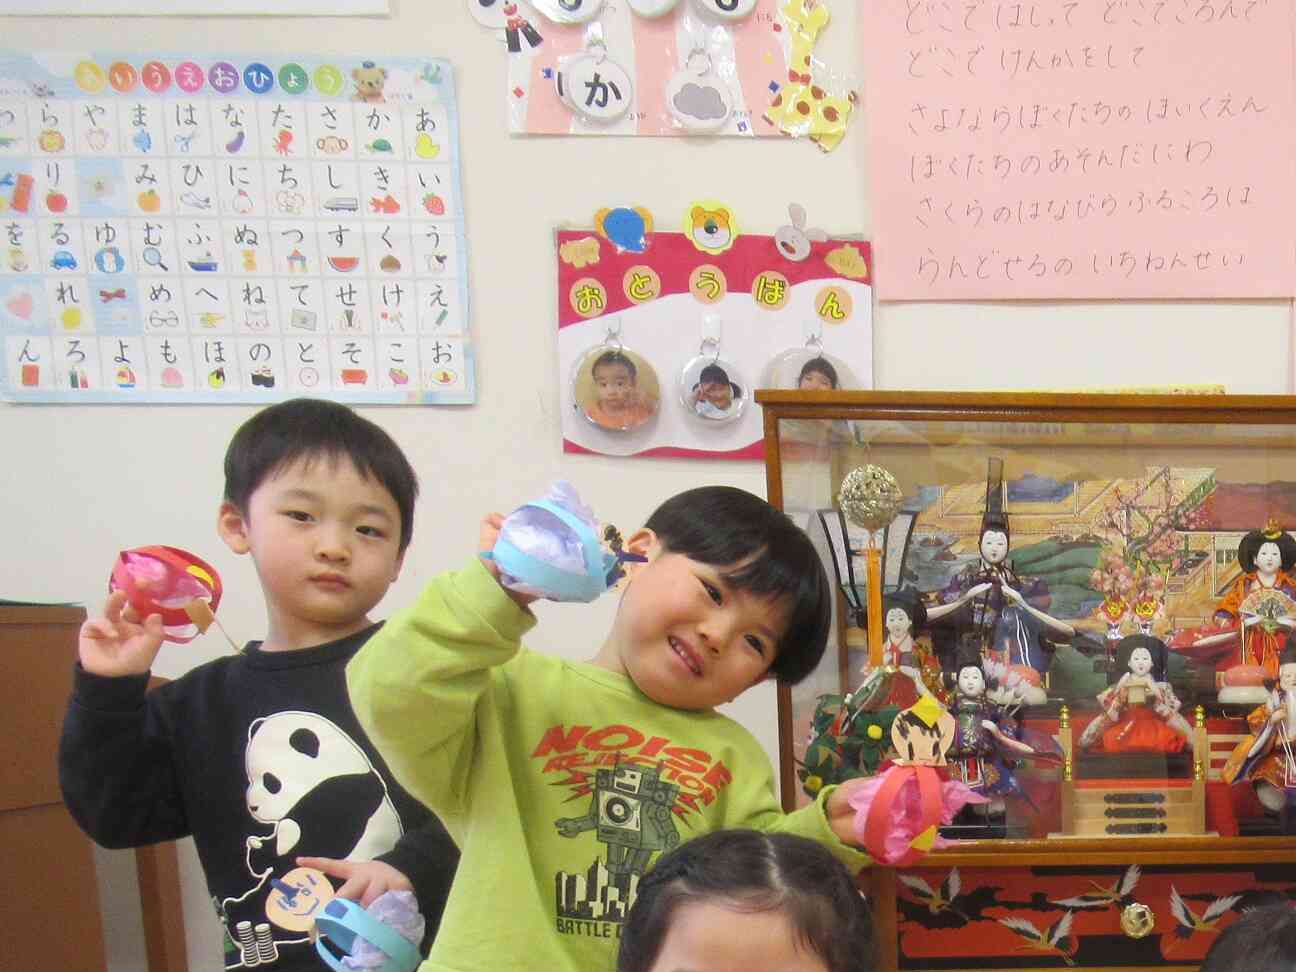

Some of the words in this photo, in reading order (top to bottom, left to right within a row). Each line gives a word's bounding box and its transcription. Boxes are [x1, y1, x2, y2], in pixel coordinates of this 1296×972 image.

[584, 73, 622, 108] か
[42, 104, 58, 126] ら
[84, 104, 104, 126] や
[132, 104, 147, 126] ま
[176, 104, 198, 126] は
[223, 104, 244, 127] な
[272, 104, 293, 128] た
[321, 106, 337, 129] さ
[367, 108, 390, 130] か
[415, 108, 436, 131] あ
[46, 163, 59, 184] り
[136, 164, 157, 183] み
[182, 165, 204, 186] ひ
[229, 165, 250, 186] に
[278, 164, 298, 188] ち
[328, 165, 342, 189] し
[374, 166, 389, 190] き
[418, 173, 440, 188] い
[6, 222, 23, 245] を
[50, 223, 70, 244] る
[95, 222, 116, 244] ゆ
[143, 222, 162, 245] む
[187, 224, 211, 245] ふ
[234, 225, 258, 245] ぬ
[281, 229, 303, 244] つ
[328, 225, 350, 247] す
[381, 226, 393, 248] く
[426, 226, 440, 248] う
[56, 282, 80, 304] れ
[151, 283, 172, 303] め
[195, 288, 218, 301] へ
[242, 282, 266, 304] ね
[290, 285, 309, 305] て
[336, 283, 357, 306] せ
[382, 284, 404, 305] け
[429, 285, 448, 307] え
[573, 271, 846, 320] おとうばん
[18, 339, 40, 362] ん
[66, 340, 86, 362] ろ
[114, 340, 131, 363] よ
[160, 340, 177, 363] も
[204, 341, 226, 363] ほ
[250, 343, 271, 361] の
[299, 343, 315, 362] と
[342, 343, 362, 364] そ
[390, 343, 404, 362] こ
[432, 341, 452, 364] お
[556, 918, 611, 938] BATTLE
